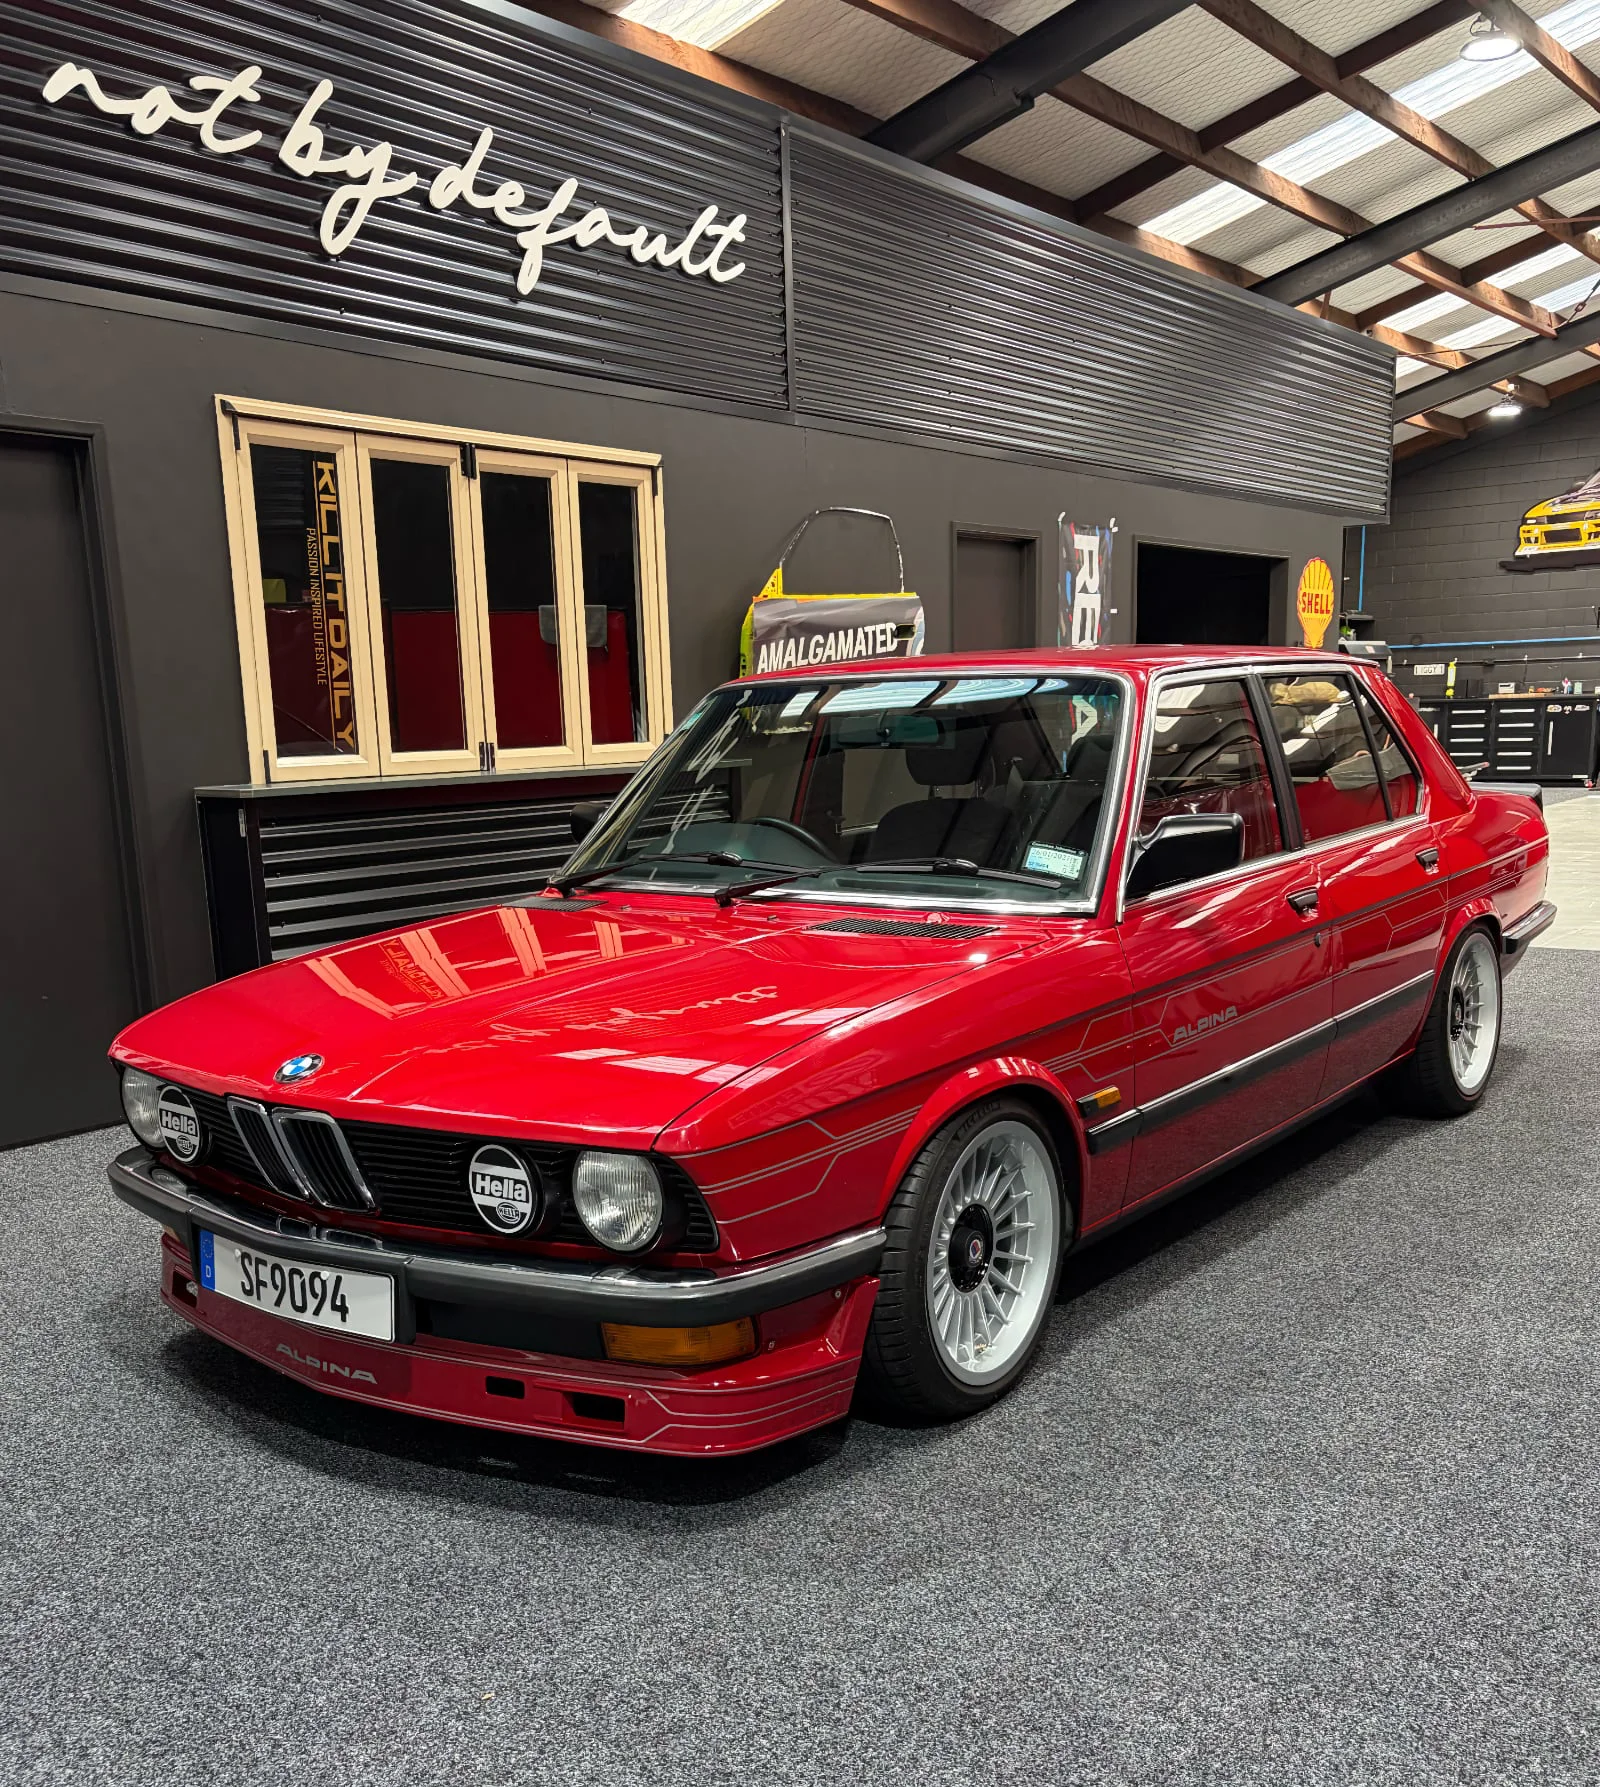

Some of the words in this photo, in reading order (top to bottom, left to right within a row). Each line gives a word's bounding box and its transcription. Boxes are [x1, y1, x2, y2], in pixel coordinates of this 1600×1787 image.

[43, 62, 262, 154] not
[279, 79, 418, 256] by
[429, 127, 747, 295] default
[306, 527, 320, 576] PASSION
[309, 579, 323, 629] INSPIRED
[1301, 591, 1331, 614] SHELL
[313, 632, 328, 686] LIFESTYLE
[756, 622, 898, 675] AMALGAMATED
[1173, 1005, 1238, 1043] ALPINA
[161, 1110, 196, 1135] Hella
[475, 1173, 527, 1202] Hella
[205, 1265, 212, 1278] D
[240, 1252, 349, 1322] SF9094
[276, 1343, 378, 1385] ALPINA
